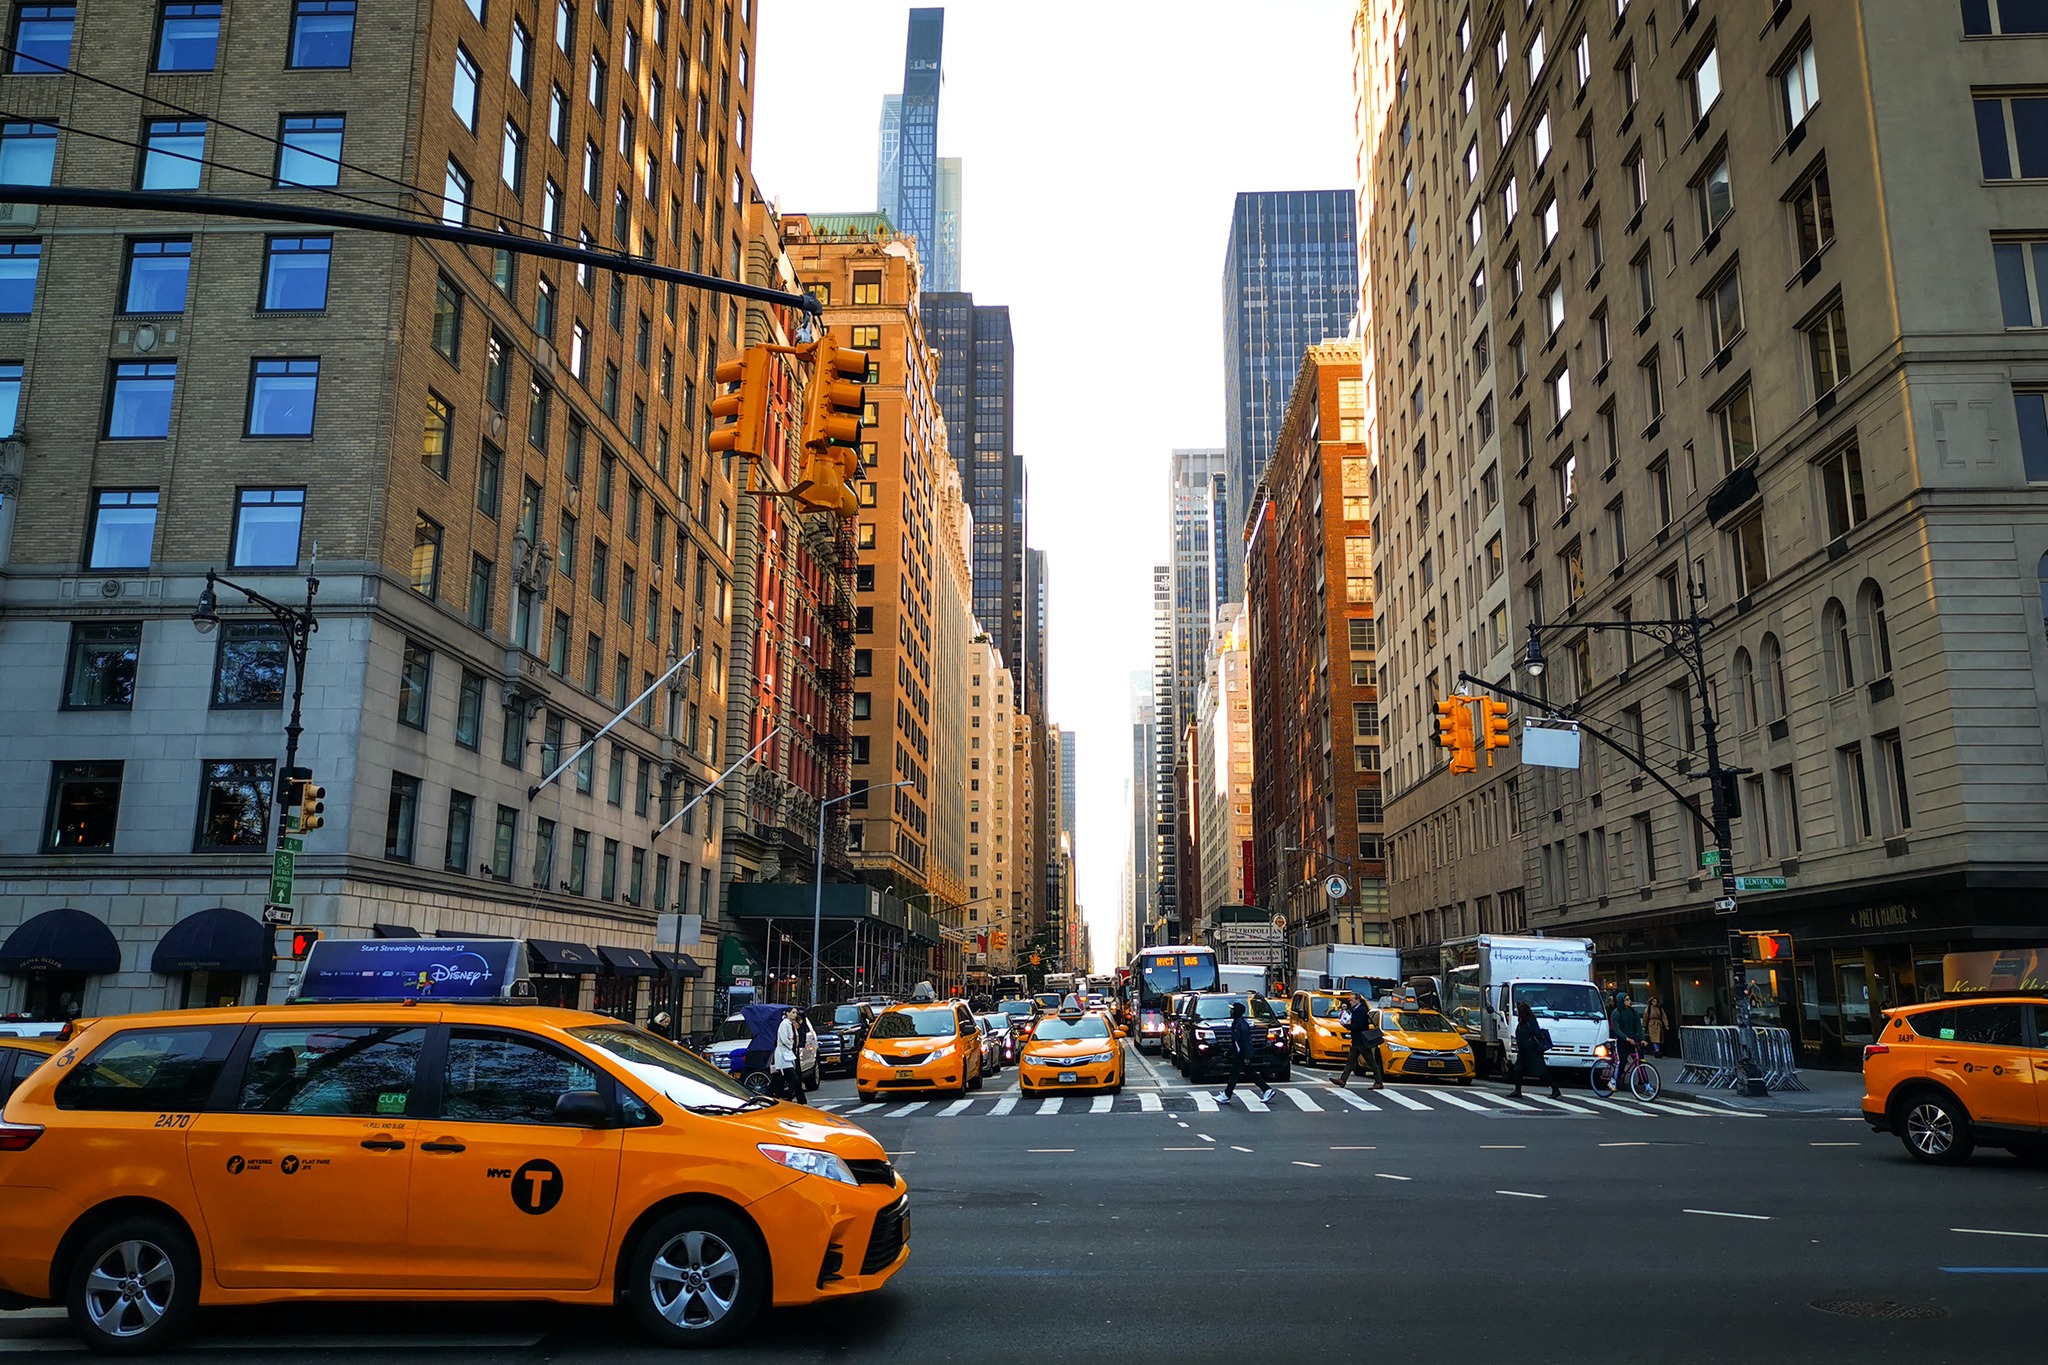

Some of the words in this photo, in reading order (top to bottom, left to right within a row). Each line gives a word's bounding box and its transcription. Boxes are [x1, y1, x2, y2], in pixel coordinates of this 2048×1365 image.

[1744, 878, 1770, 886] CENTRAL
[268, 910, 277, 919] ONE
[280, 911, 290, 920] WAY
[360, 944, 379, 952] Start
[380, 944, 416, 953] Streaming
[1156, 957, 1175, 967] NYCT
[1184, 956, 1199, 966] BUS
[430, 962, 493, 986] Disney+
[379, 1094, 407, 1103] curb
[154, 1114, 191, 1128] 2A70
[487, 1168, 512, 1179] NYC
[524, 1170, 553, 1208] T
